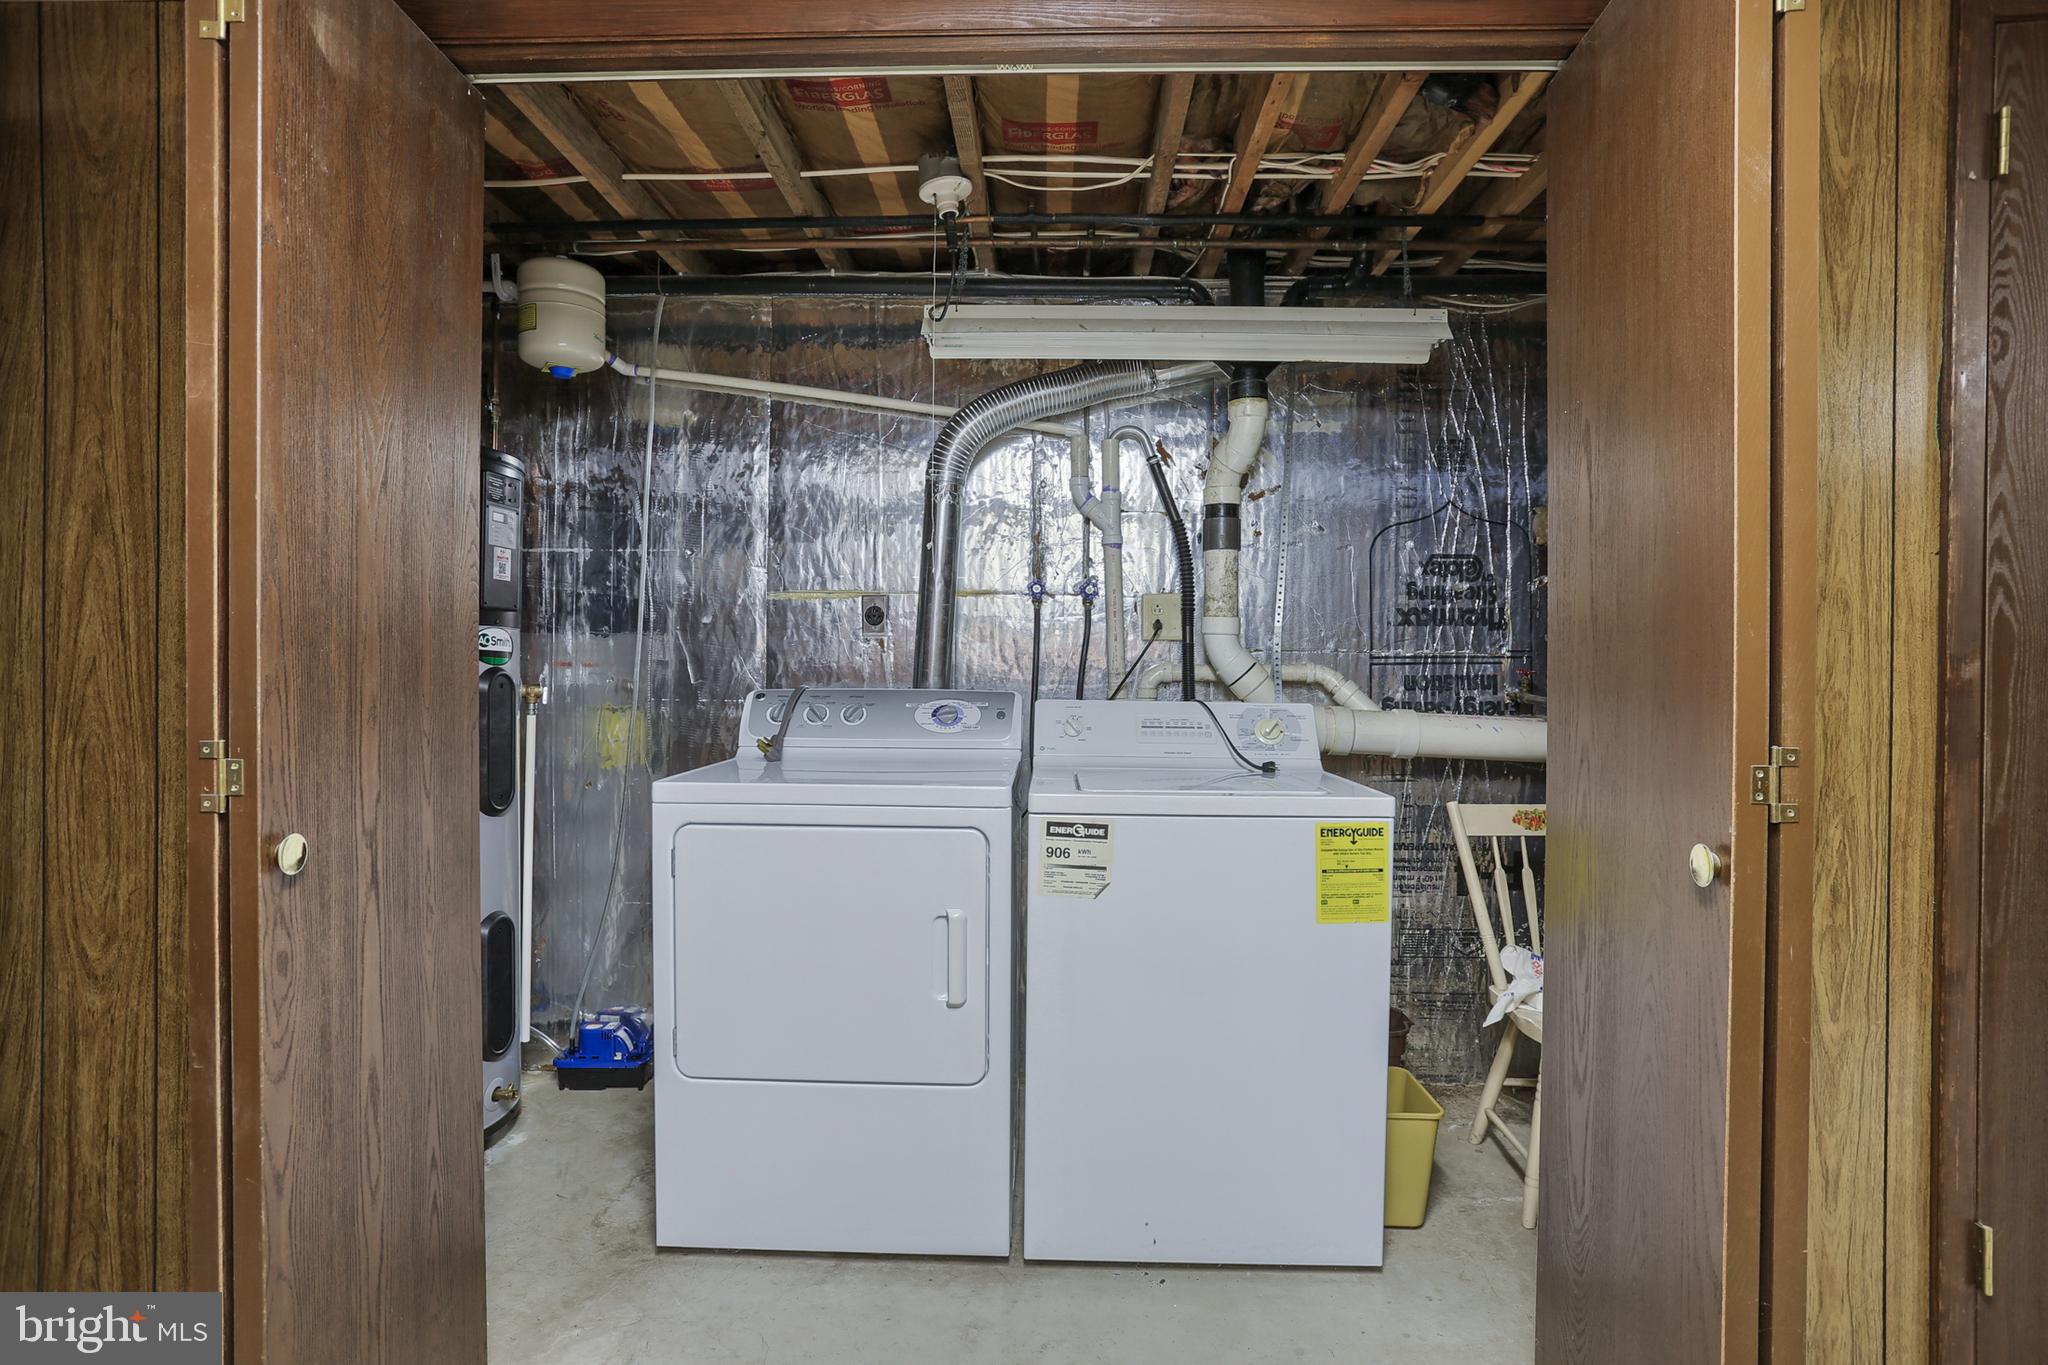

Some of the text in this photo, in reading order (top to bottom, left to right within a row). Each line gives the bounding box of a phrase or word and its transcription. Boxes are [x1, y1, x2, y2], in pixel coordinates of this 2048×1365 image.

[1404, 675, 1498, 696] Insulation
[1049, 824, 1106, 838] ENERGUIDE
[1320, 827, 1384, 840] ENERGYGUIDE
[1046, 846, 1071, 859] 906
